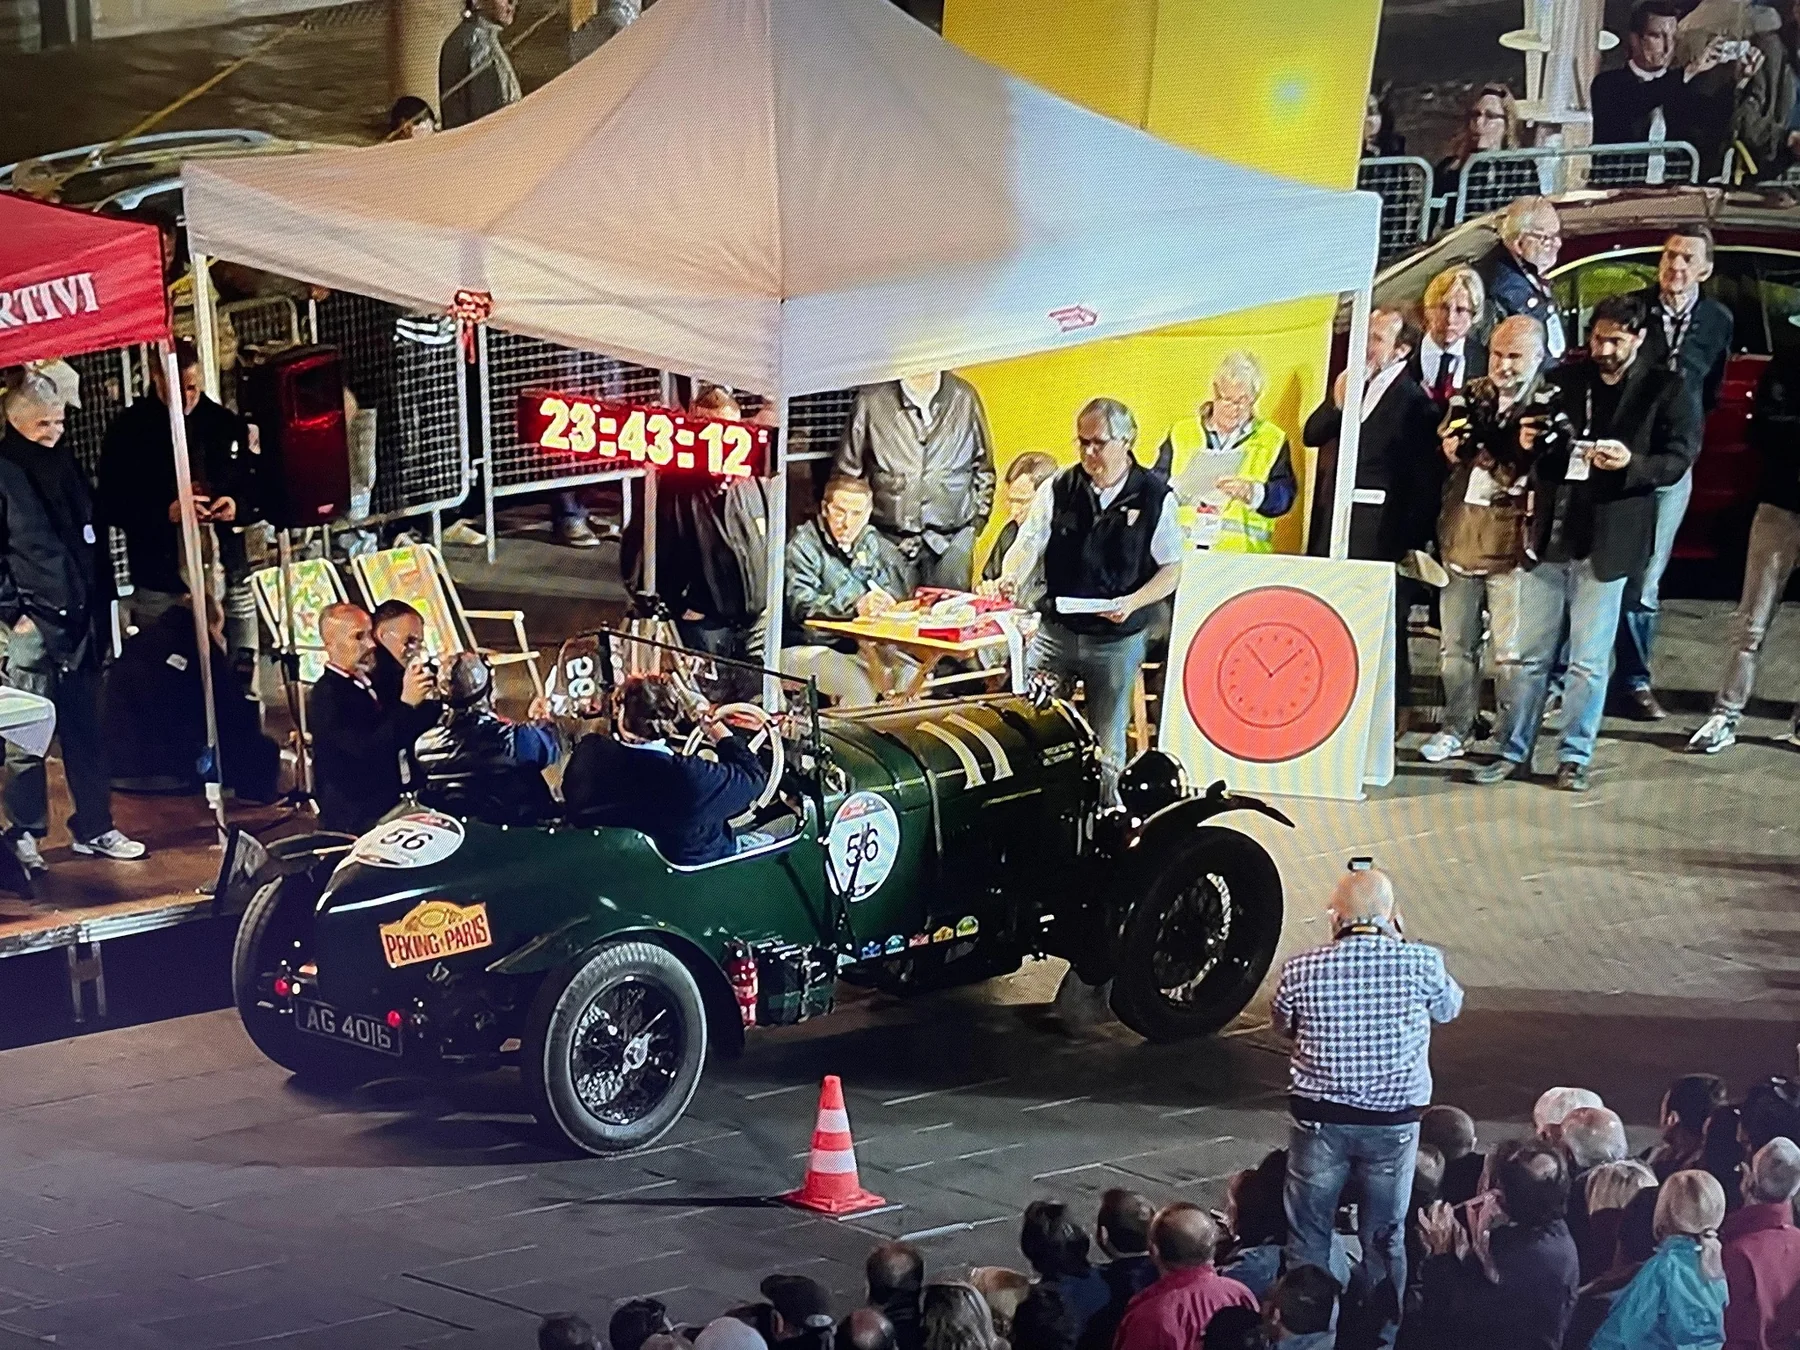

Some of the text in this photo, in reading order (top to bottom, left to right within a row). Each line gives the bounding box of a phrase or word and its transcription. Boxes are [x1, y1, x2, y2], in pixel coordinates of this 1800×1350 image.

[539, 397, 752, 477] 23:43:12
[380, 827, 433, 850] 56
[846, 825, 879, 868] 56
[385, 932, 440, 963] PEKING
[444, 914, 488, 951] PARIS
[307, 1006, 336, 1033] AG
